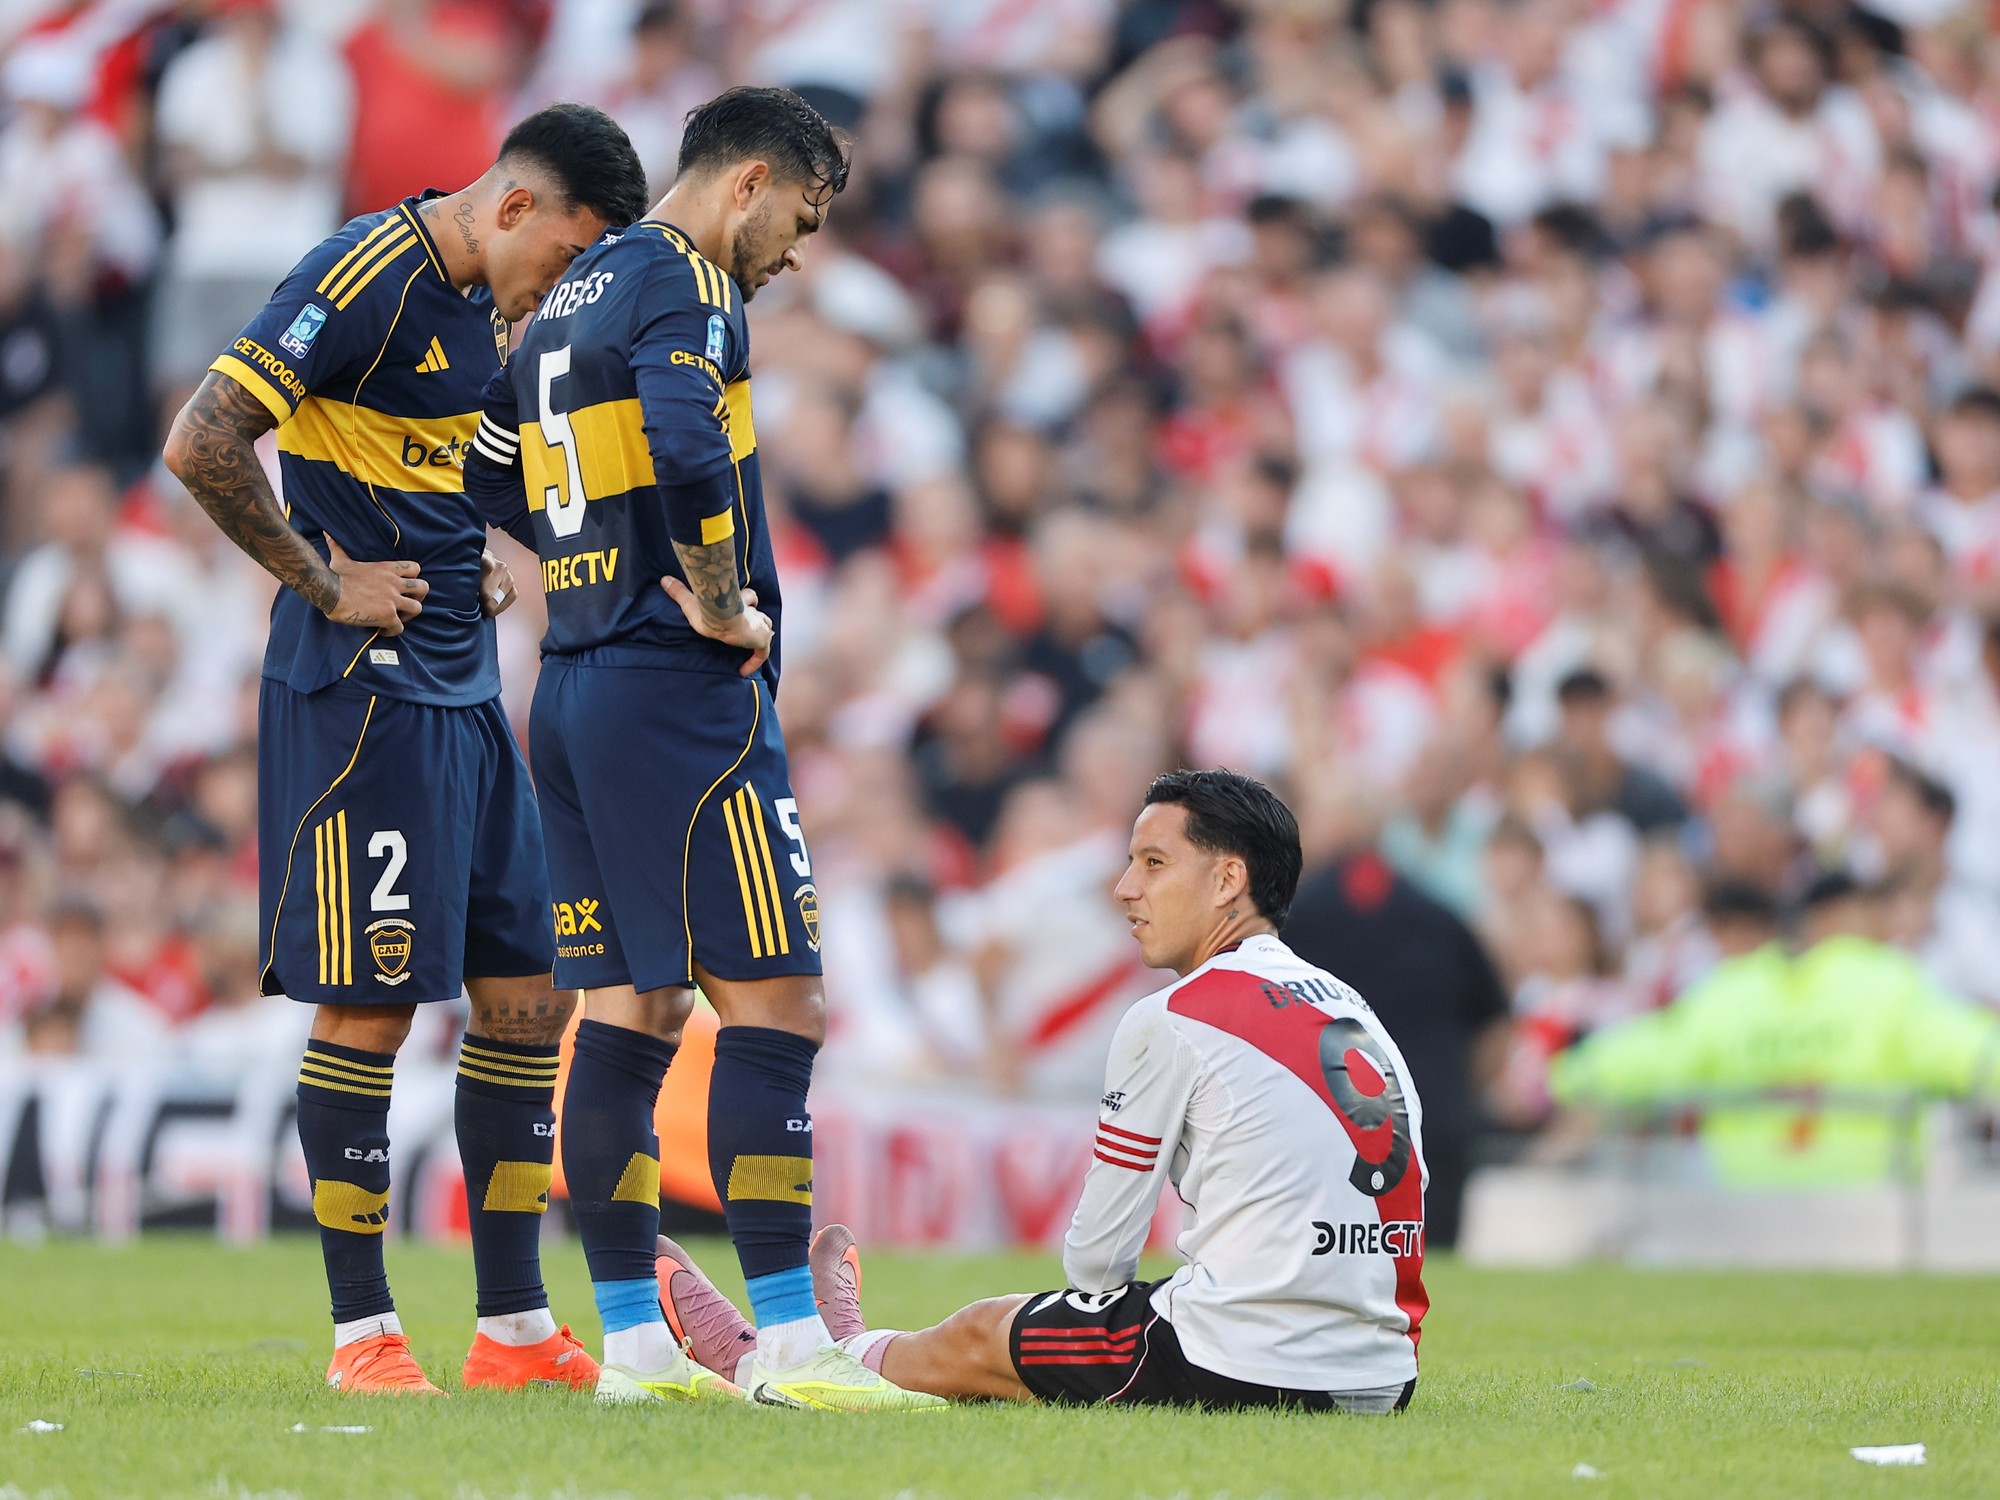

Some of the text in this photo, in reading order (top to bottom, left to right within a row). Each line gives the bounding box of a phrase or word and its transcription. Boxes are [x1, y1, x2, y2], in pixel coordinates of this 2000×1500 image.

[233, 336, 306, 402] CETROGAR
[281, 332, 308, 354] LPF
[538, 343, 587, 539] 5
[367, 829, 411, 912] 2
[774, 797, 811, 877] 5
[377, 944, 405, 955] CABJ
[1318, 1016, 1411, 1197] 9
